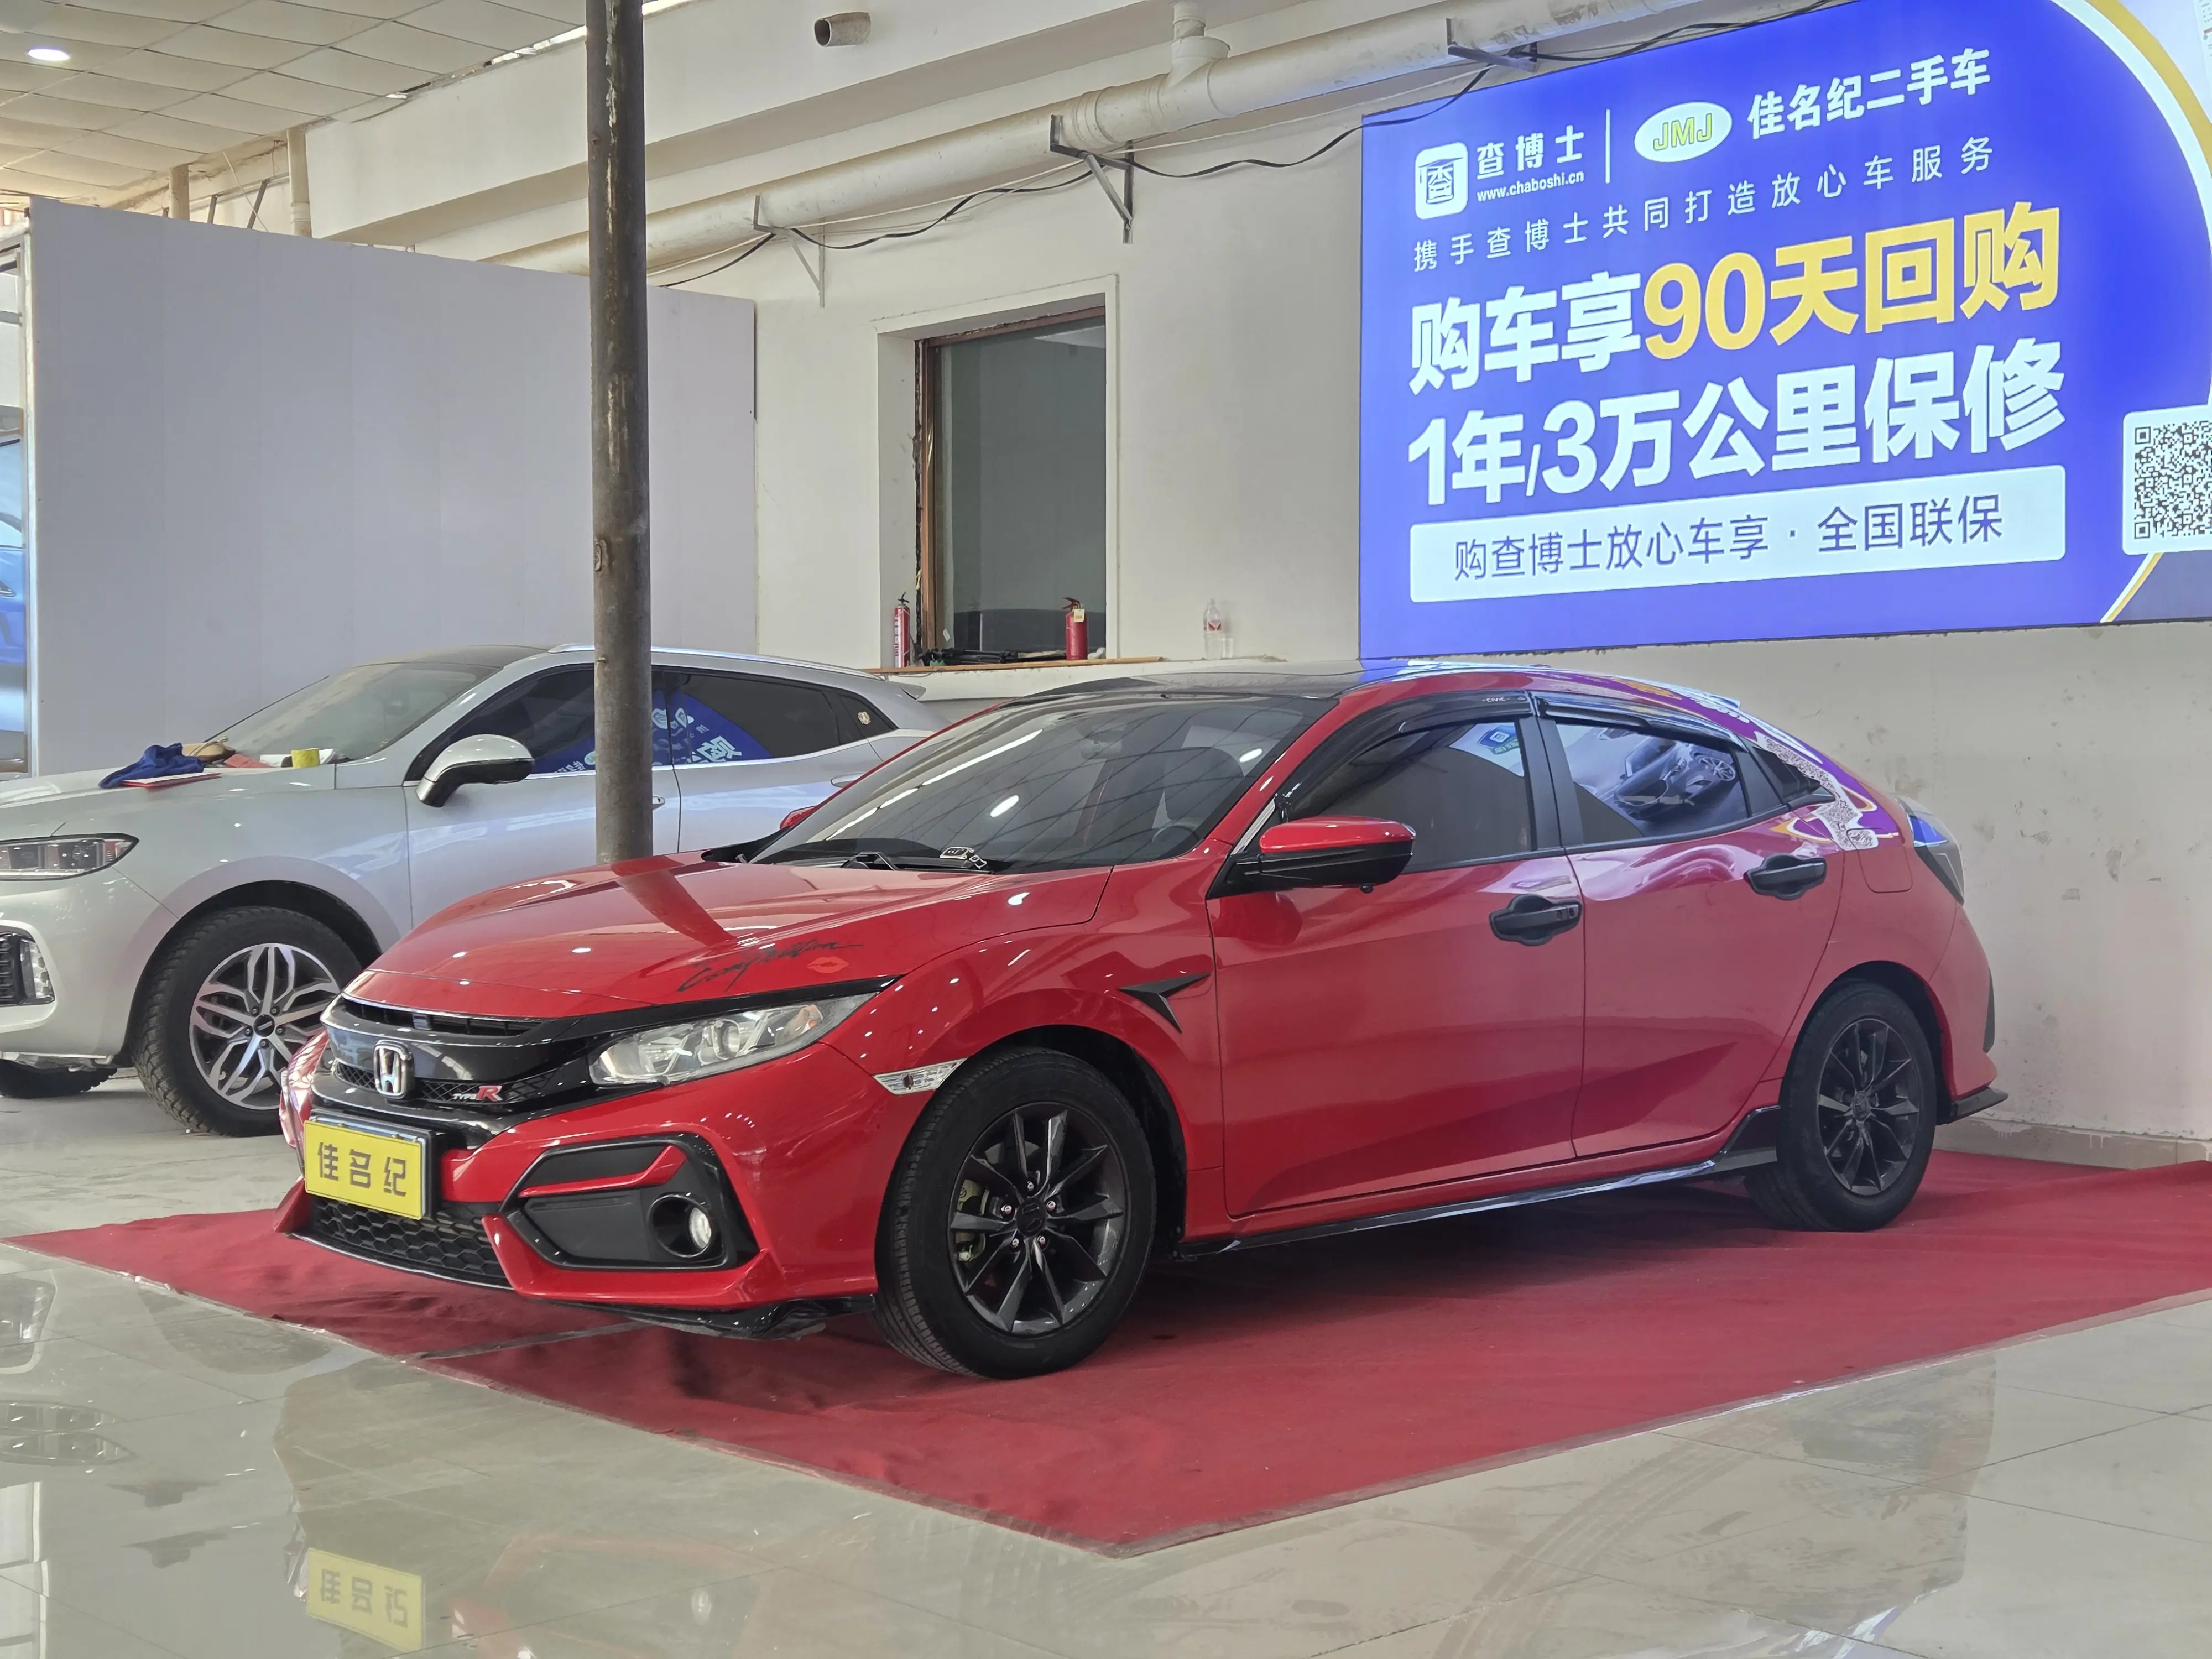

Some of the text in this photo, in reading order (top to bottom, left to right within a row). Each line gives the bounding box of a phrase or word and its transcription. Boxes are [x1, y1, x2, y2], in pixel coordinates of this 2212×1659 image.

[1747, 48, 1991, 139] 佳名纪二手车
[1476, 124, 1585, 180] 查博士
[1653, 112, 1713, 151] JMJ
[1413, 136, 1993, 272] 携手查博士共同打造放心车服务
[1476, 170, 1585, 202] www.chaboshi.cn
[1408, 201, 2060, 396] 购车享90天回购
[1408, 337, 2066, 505] 1年/3万公里保修
[476, 1086, 503, 1102] R
[317, 1141, 407, 1198] 佳名纪
